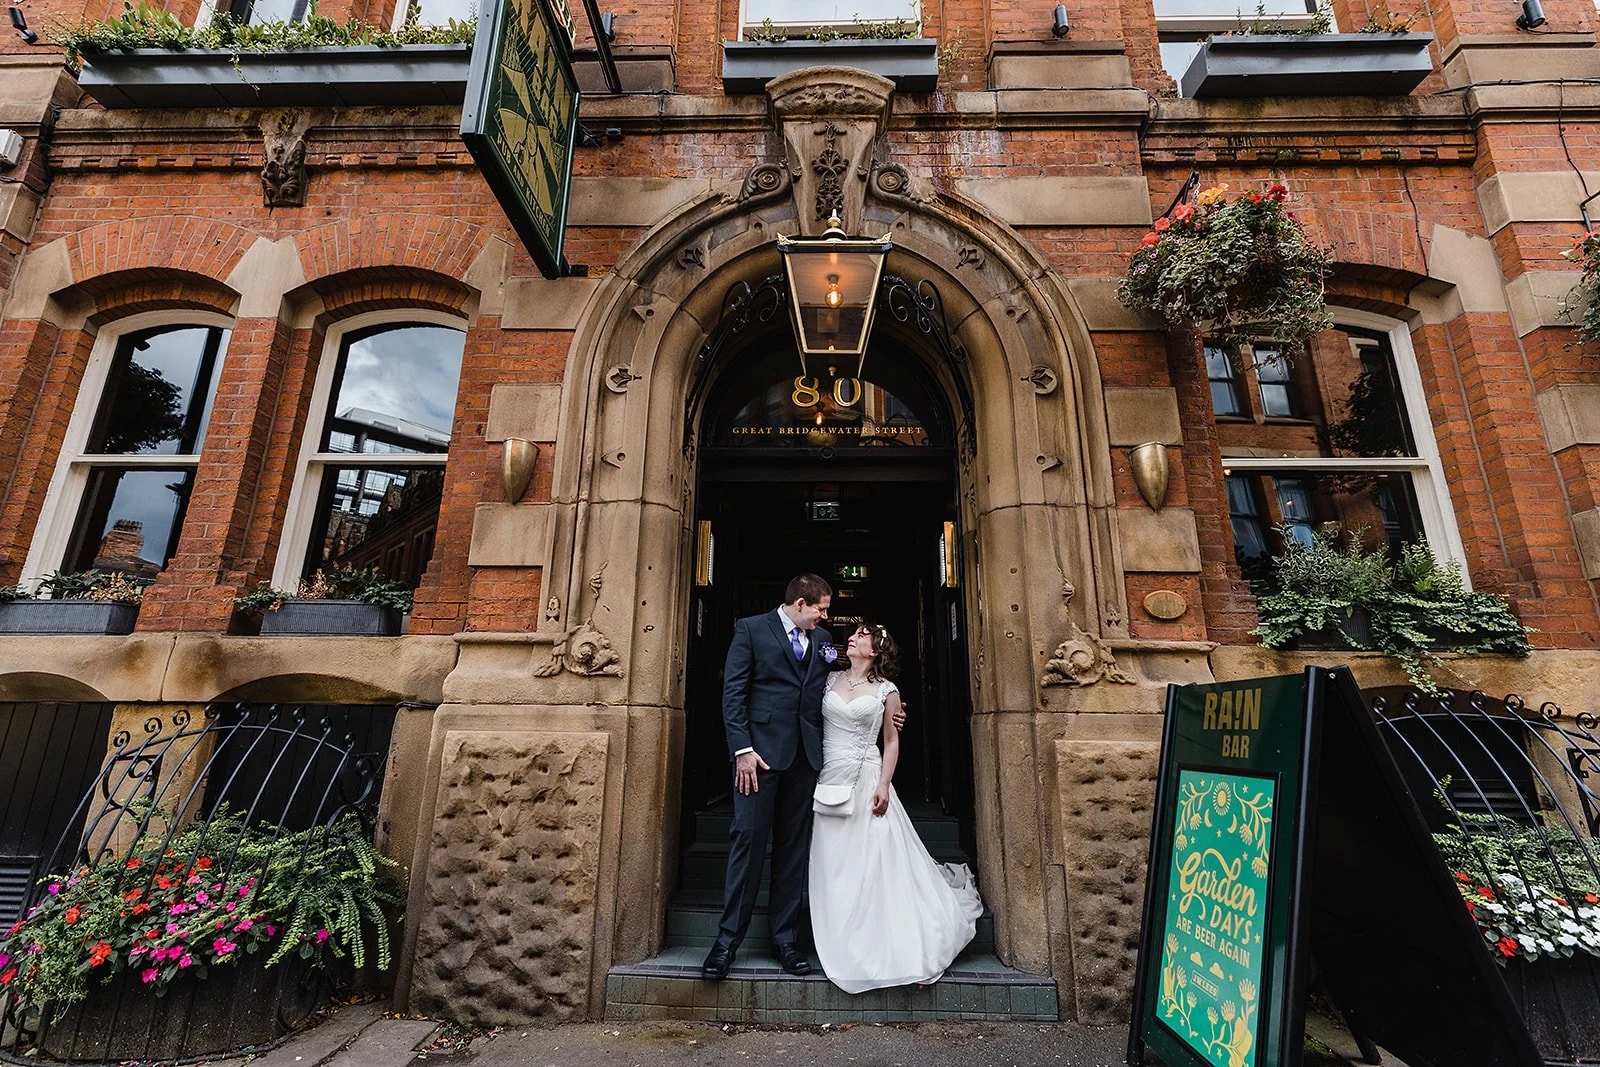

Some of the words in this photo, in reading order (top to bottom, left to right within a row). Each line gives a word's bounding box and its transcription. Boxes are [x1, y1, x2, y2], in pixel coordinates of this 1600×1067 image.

[532, 66, 559, 141] BAR
[497, 131, 511, 164] PUB
[512, 163, 525, 188] AND
[526, 185, 551, 238] KITCHEN
[791, 375, 862, 408] 80
[732, 426, 774, 435] GREAT
[779, 426, 869, 435] BRIDGEWATER
[875, 426, 923, 435] STREET
[1203, 687, 1262, 731] RA!N
[1221, 734, 1250, 759] BAR
[1175, 848, 1258, 920] Garden
[1175, 914, 1193, 935] ARE
[1194, 923, 1217, 949] BEER
[1218, 938, 1251, 969] AGAIN
[1209, 904, 1253, 945] DAYS
